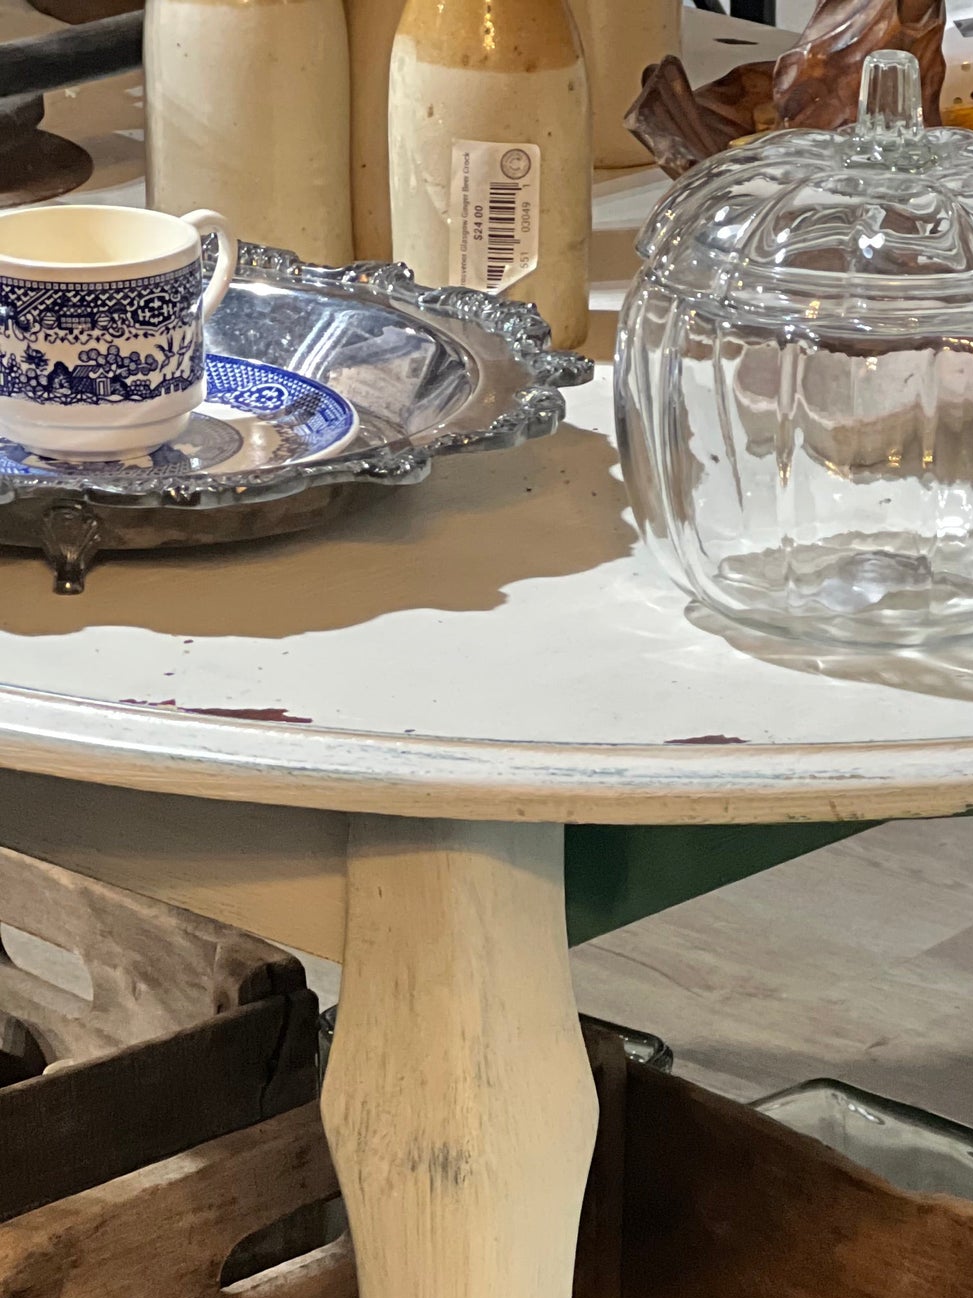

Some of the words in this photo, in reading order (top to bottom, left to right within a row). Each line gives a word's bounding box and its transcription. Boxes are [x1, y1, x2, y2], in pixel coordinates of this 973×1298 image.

[462, 152, 471, 174] Crock
[462, 174, 470, 193] Beer
[461, 195, 471, 219] Ginger
[520, 201, 532, 233] 03049
[460, 220, 470, 251] Glasgow
